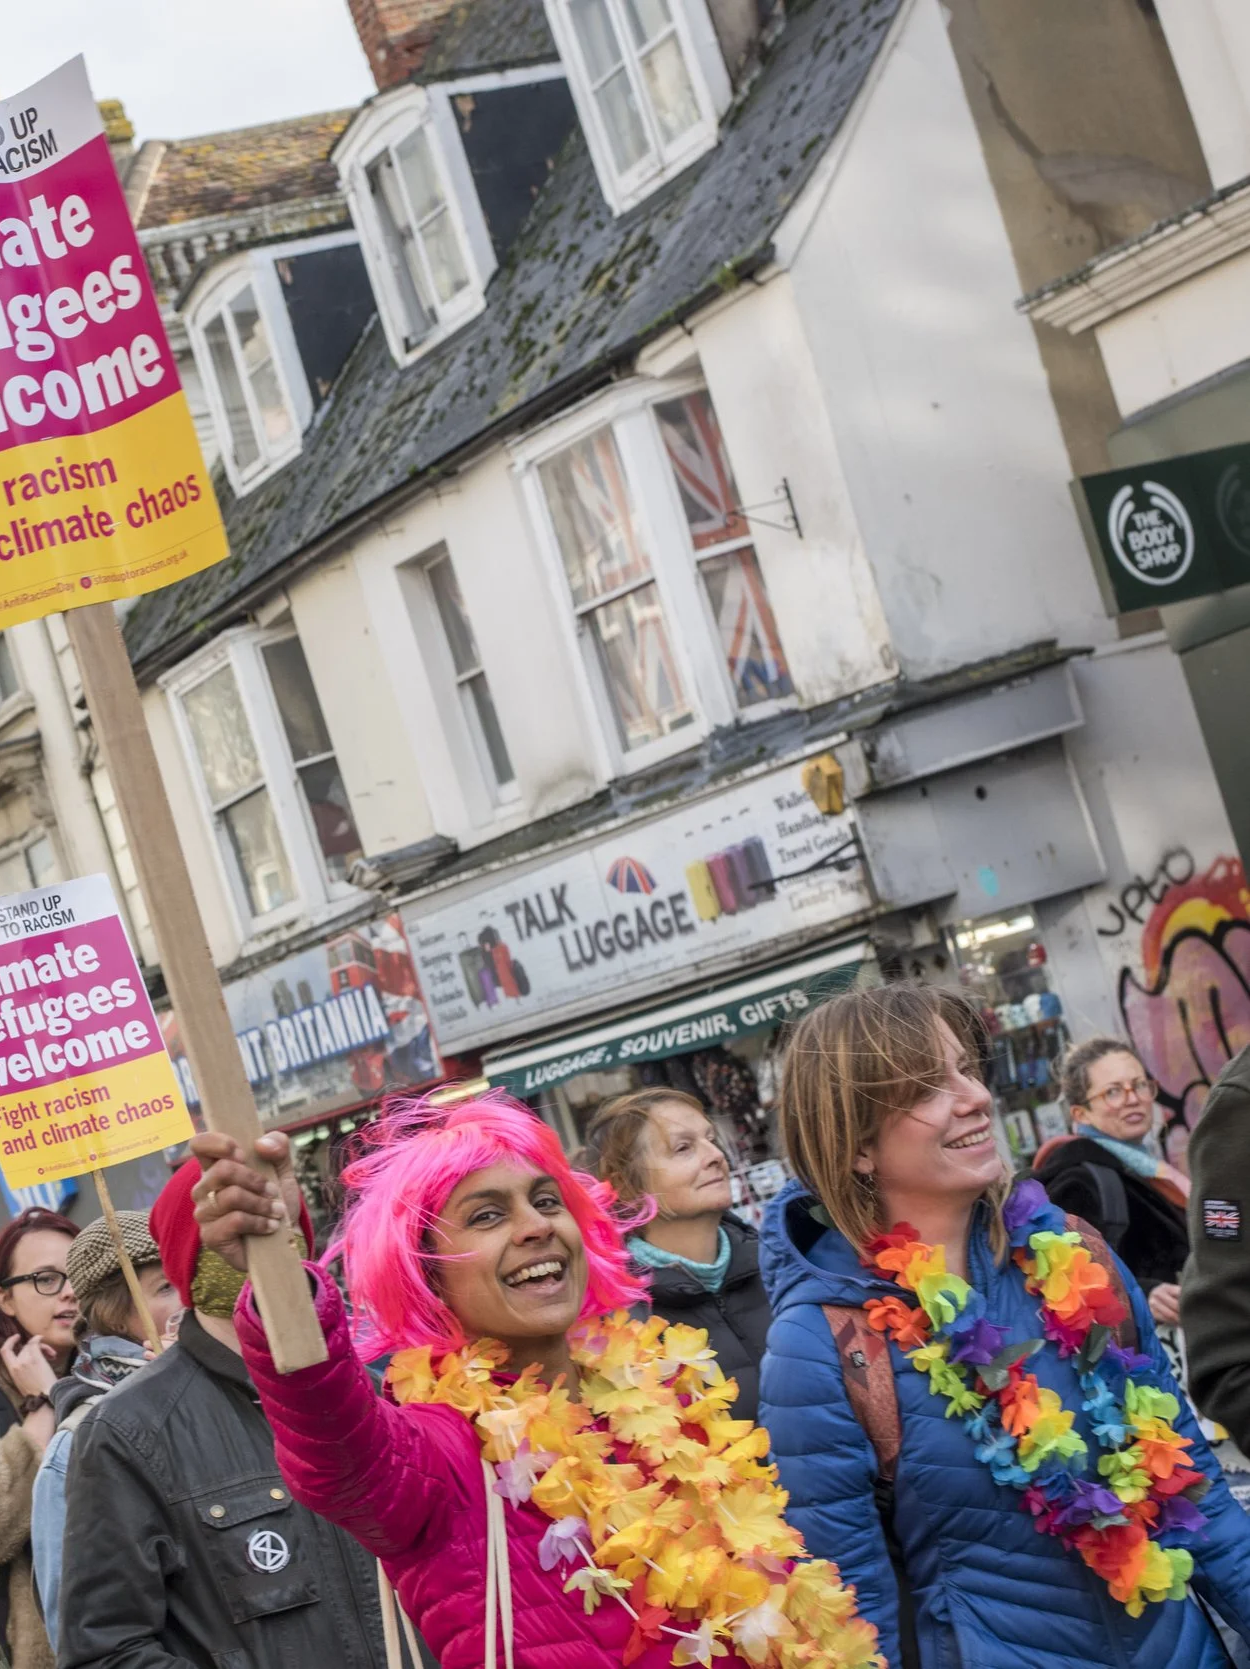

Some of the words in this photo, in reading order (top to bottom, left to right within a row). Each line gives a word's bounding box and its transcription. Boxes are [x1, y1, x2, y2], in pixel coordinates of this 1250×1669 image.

[9, 107, 39, 140] UP
[3, 456, 118, 507] racism
[126, 473, 201, 529] chaos
[1127, 523, 1176, 550] BODY
[1132, 509, 1163, 530] THE
[1134, 543, 1182, 571] SHOP
[0, 922, 21, 939] TO
[23, 908, 76, 934] RACISM
[41, 894, 62, 913] UP
[504, 882, 578, 942] TALK
[559, 892, 695, 972] LUGGAGE
[265, 984, 390, 1073] BRITANNIA
[618, 1013, 737, 1060] SOUVENIR,
[738, 988, 809, 1026] GIFTS
[43, 1083, 111, 1117] racism
[2, 1129, 37, 1156] and
[42, 1109, 110, 1147] climate
[116, 1092, 175, 1124] chaos
